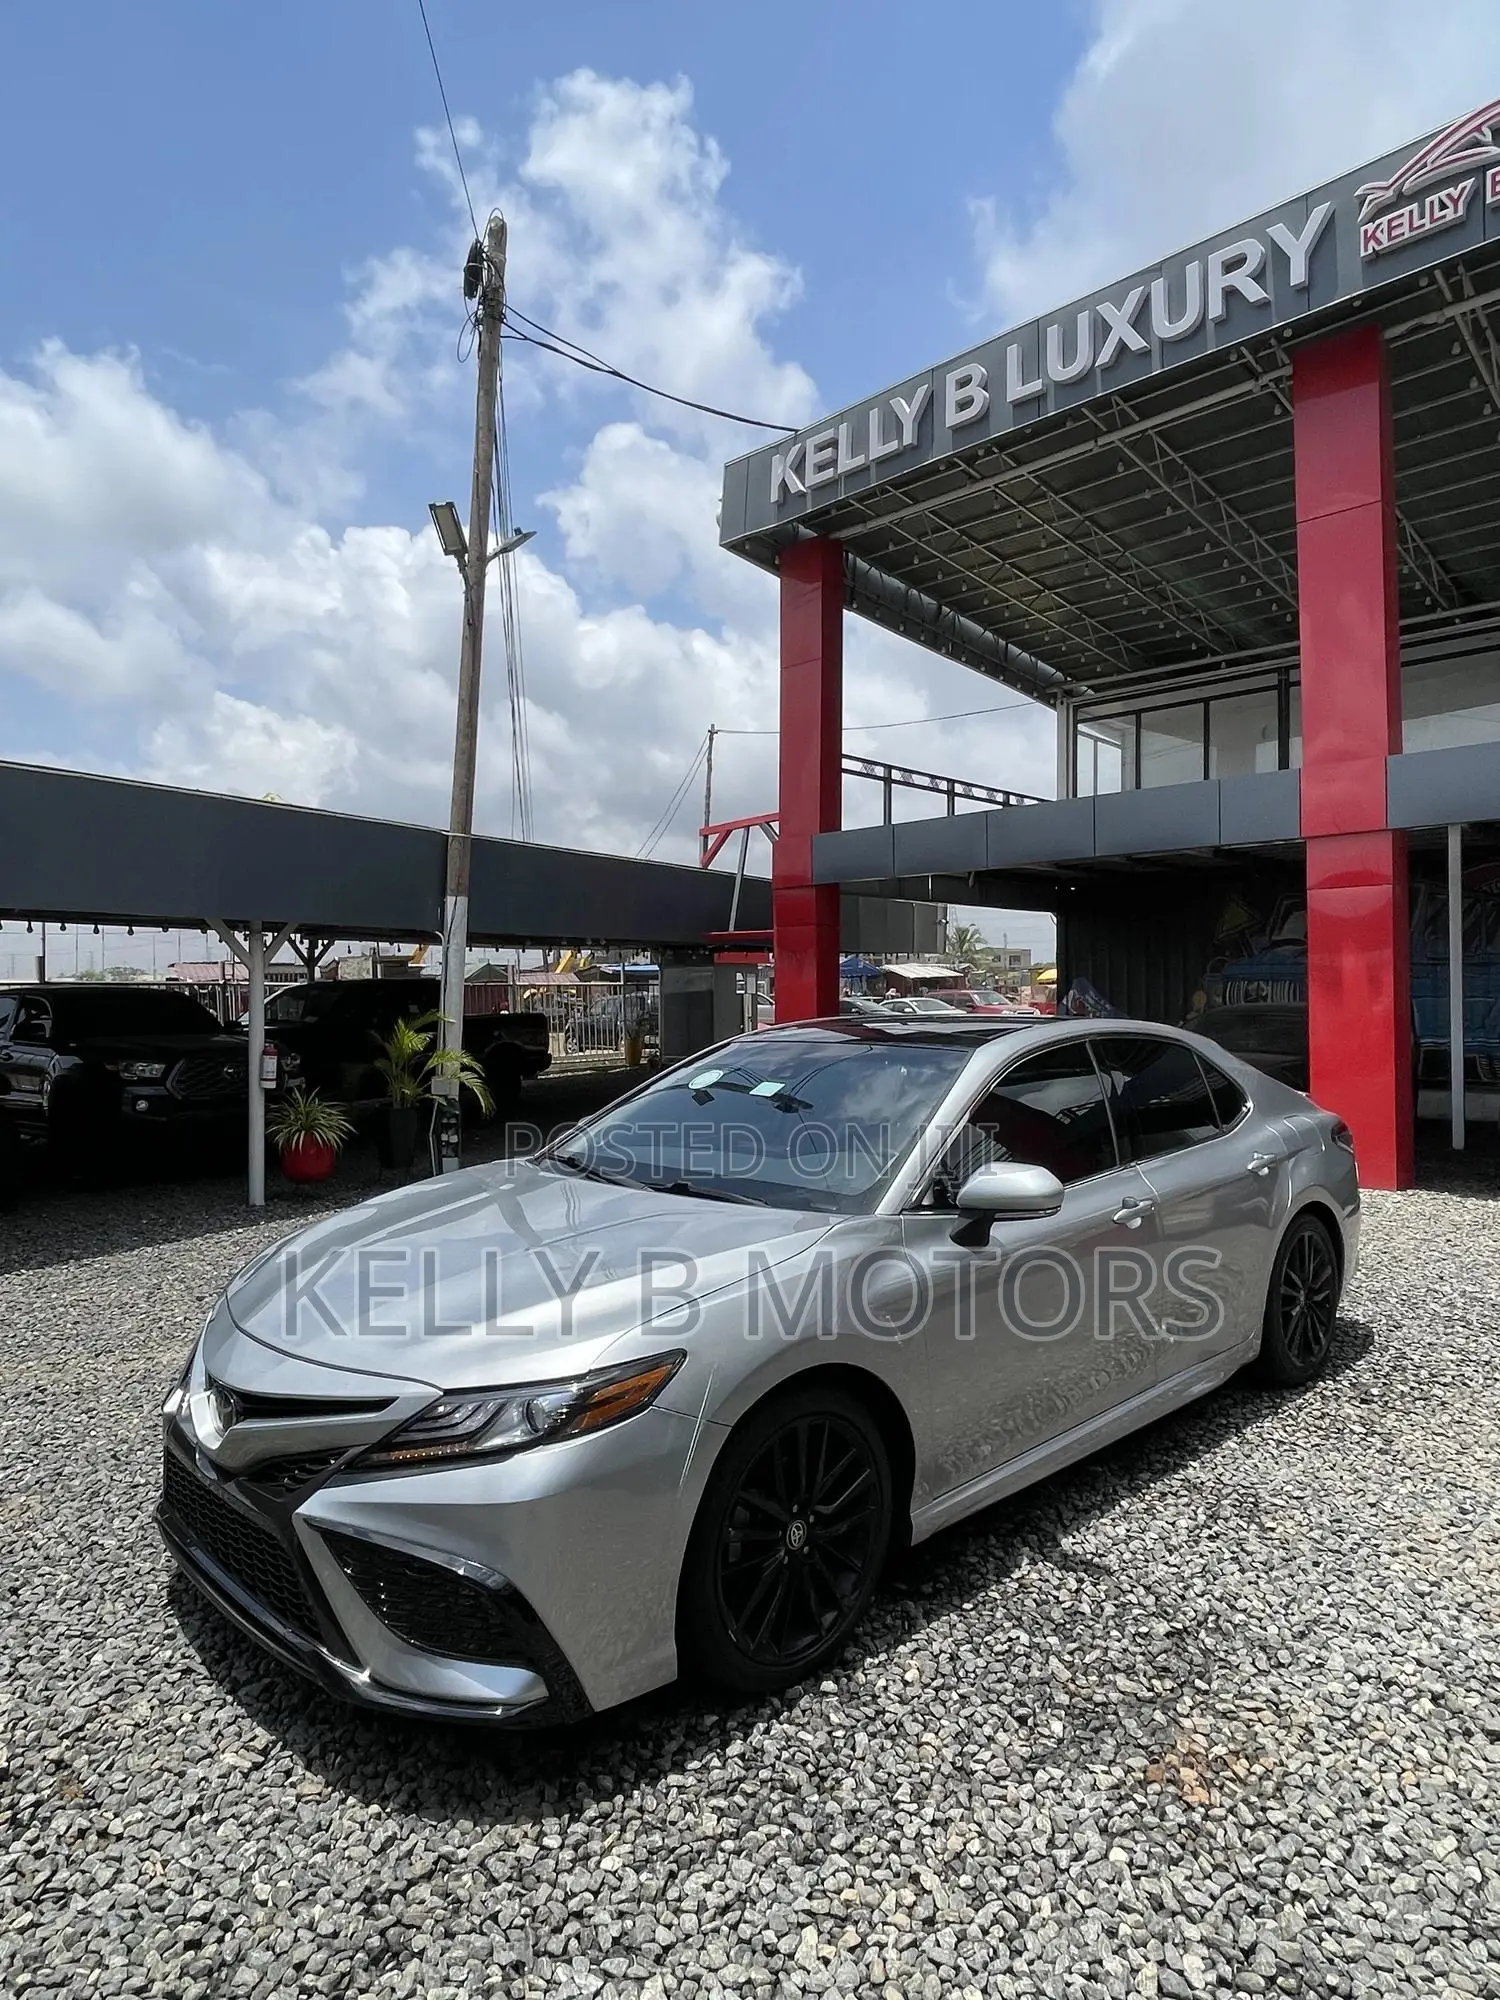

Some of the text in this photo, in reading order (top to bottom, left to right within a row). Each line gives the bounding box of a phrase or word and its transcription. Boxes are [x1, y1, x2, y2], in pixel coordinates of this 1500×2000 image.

[1360, 178, 1475, 260] KELLY
[769, 201, 1335, 503] KELLY B LUXURY
